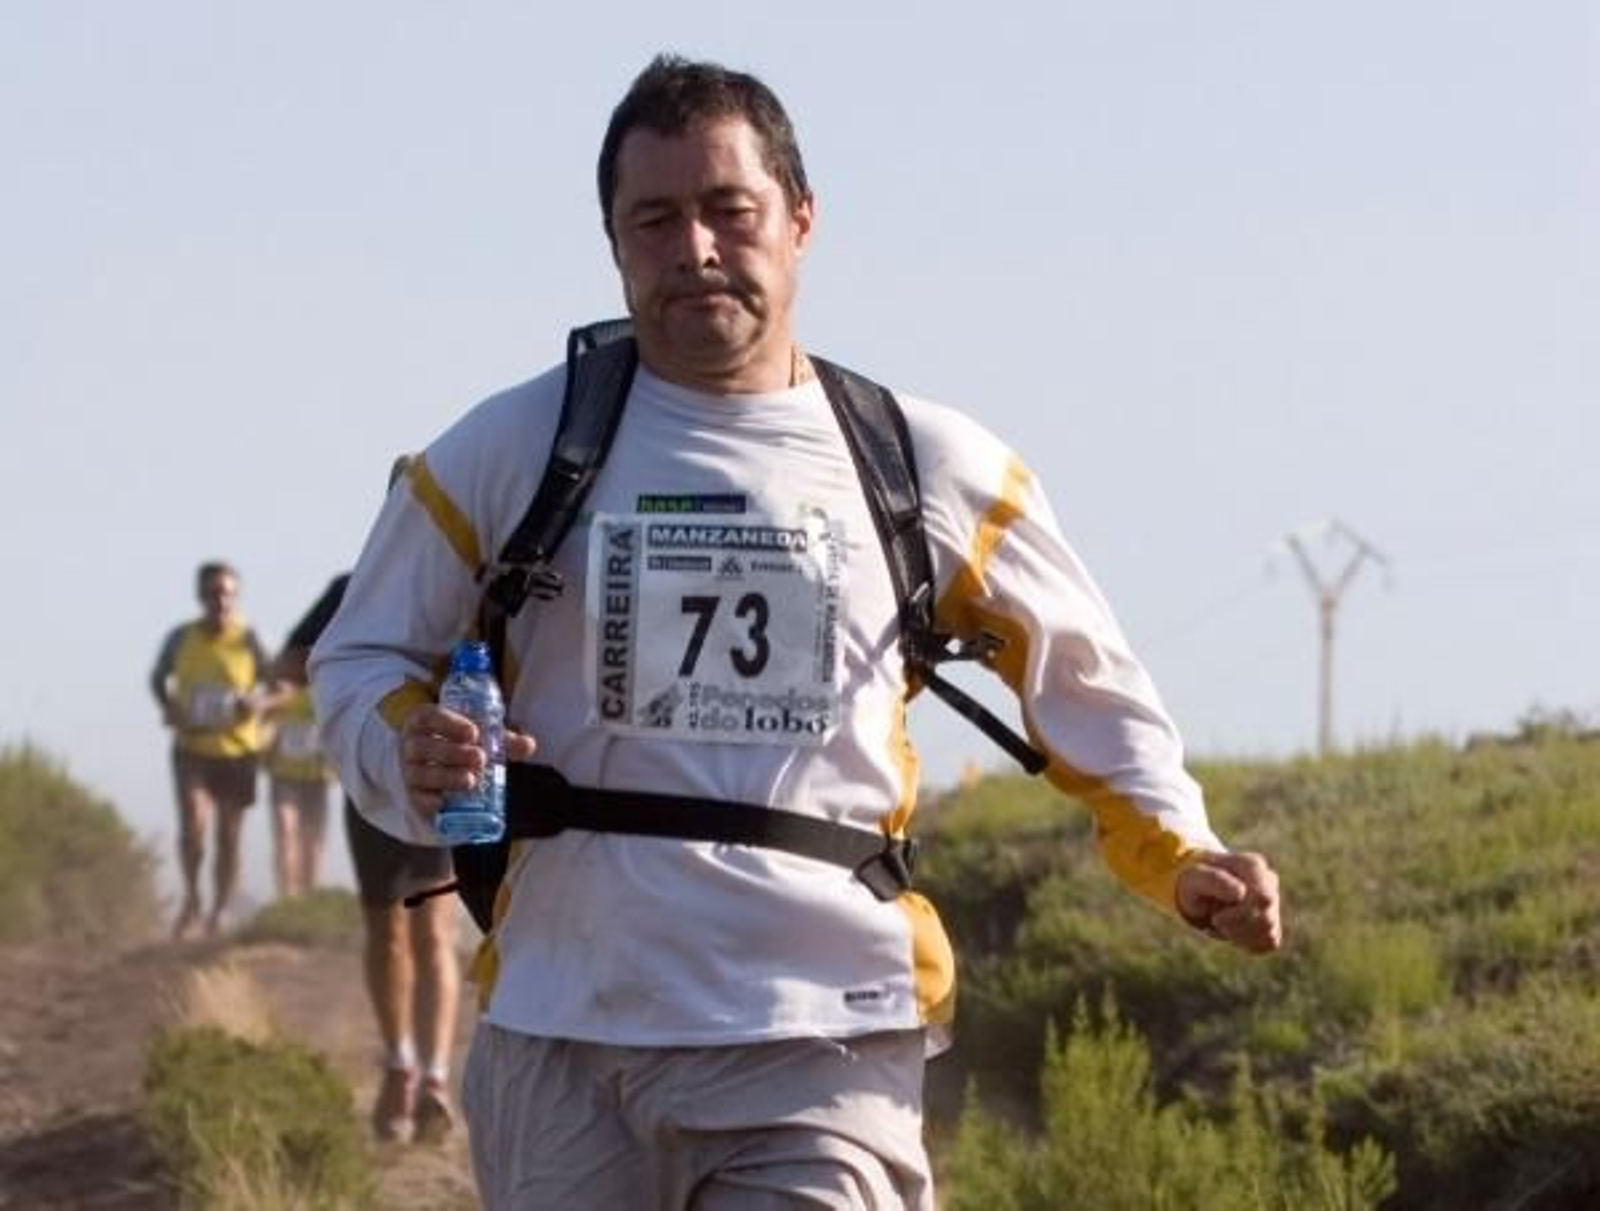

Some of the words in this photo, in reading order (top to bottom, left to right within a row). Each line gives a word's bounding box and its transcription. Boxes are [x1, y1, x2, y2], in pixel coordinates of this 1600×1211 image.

[651, 527, 808, 549] MANZANEDA
[600, 527, 635, 721] CARREIRA
[679, 591, 771, 679] 73
[701, 706, 739, 731] do
[744, 705, 828, 735] lobo
